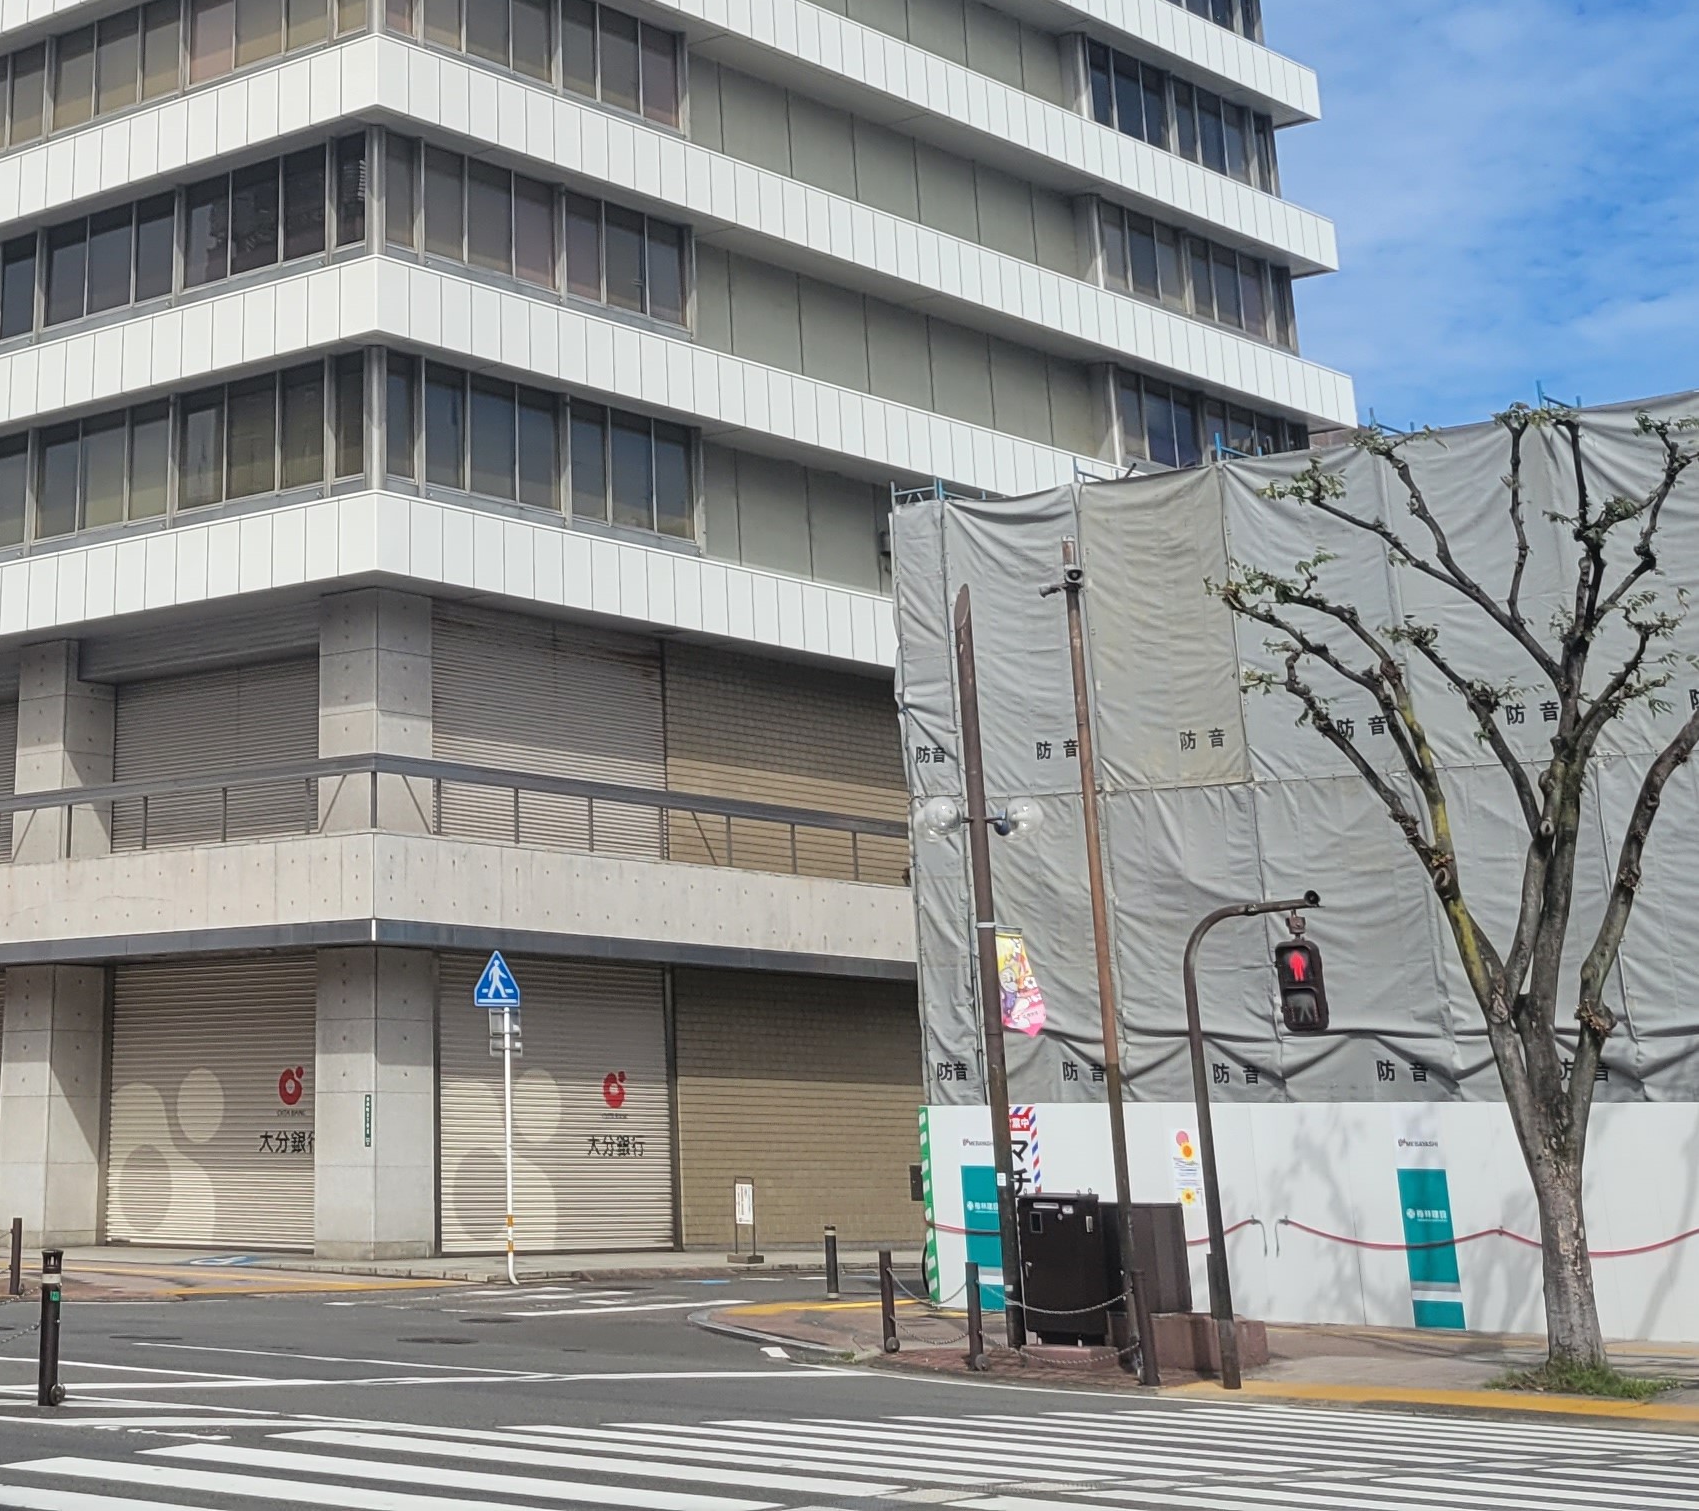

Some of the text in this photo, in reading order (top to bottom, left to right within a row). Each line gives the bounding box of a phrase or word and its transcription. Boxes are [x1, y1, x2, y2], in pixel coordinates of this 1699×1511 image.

[1505, 700, 1560, 725] 防音
[1336, 715, 1388, 738] 防音
[1036, 738, 1079, 760] 防音
[1179, 727, 1226, 751] 防音
[915, 745, 946, 764] 防音
[937, 1061, 968, 1081] 防音
[1062, 1061, 1106, 1082] 防音
[1212, 1063, 1260, 1084] 防音
[1376, 1059, 1428, 1082] 防音
[587, 1135, 646, 1157] 大分銀行
